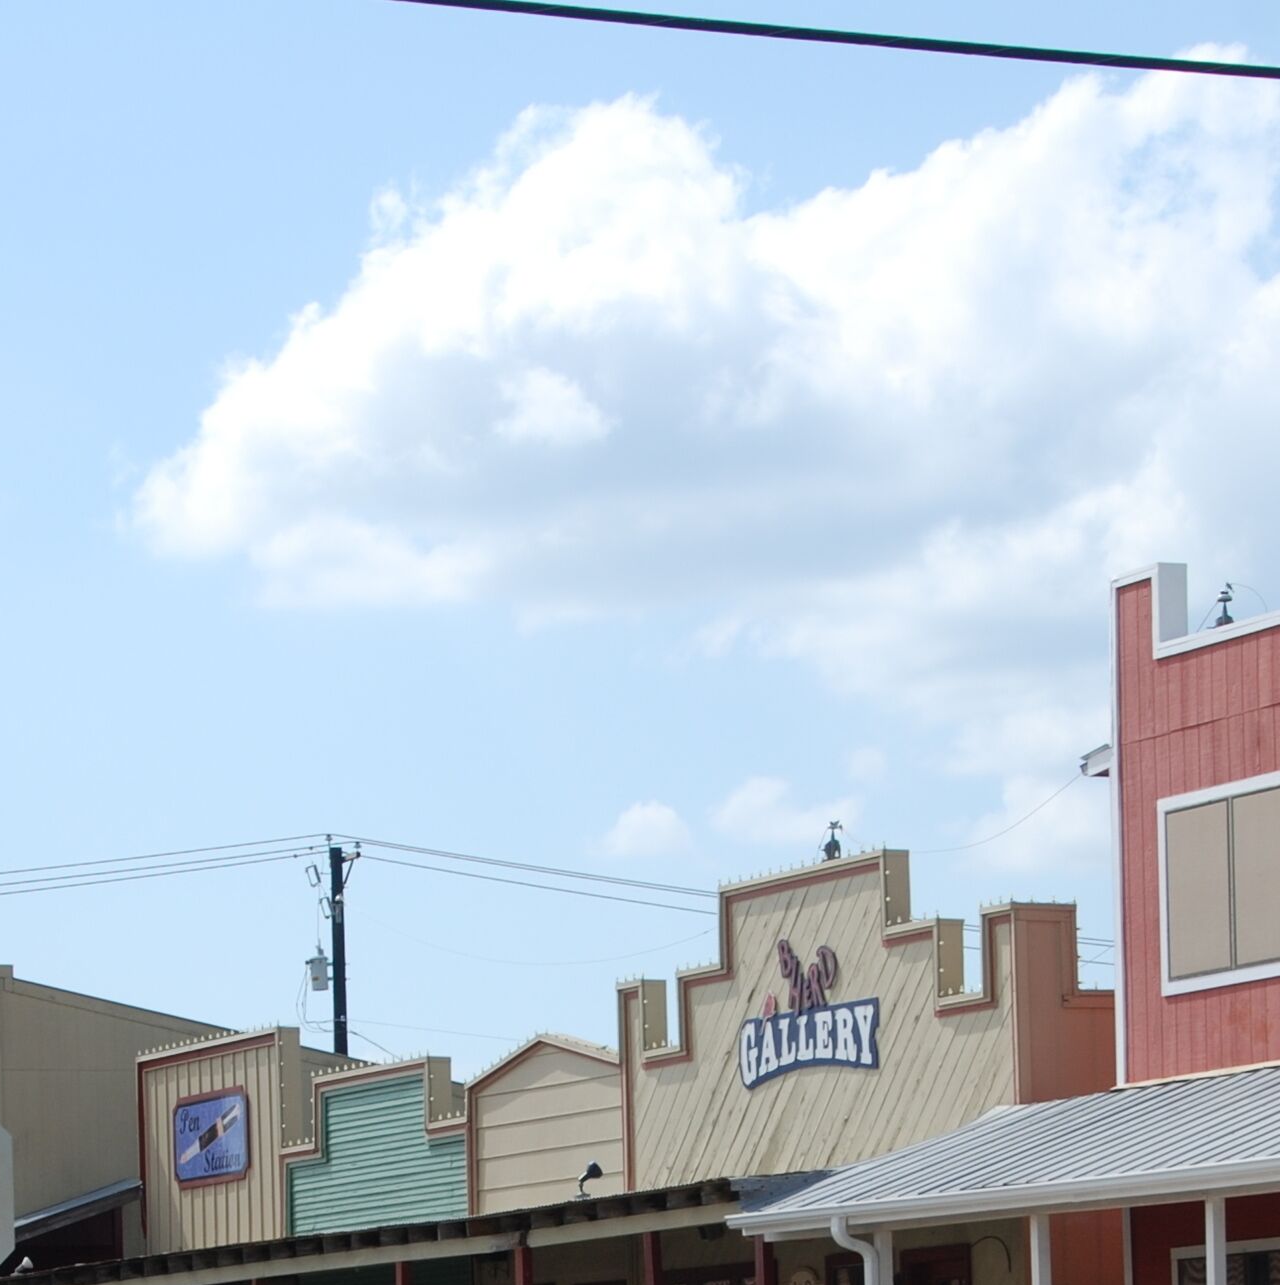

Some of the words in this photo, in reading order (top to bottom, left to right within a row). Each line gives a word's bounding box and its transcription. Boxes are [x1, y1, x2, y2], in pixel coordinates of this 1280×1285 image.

[740, 1004, 874, 1087] GALLERY
[179, 1109, 201, 1135] Pen
[204, 1150, 241, 1174] Station
